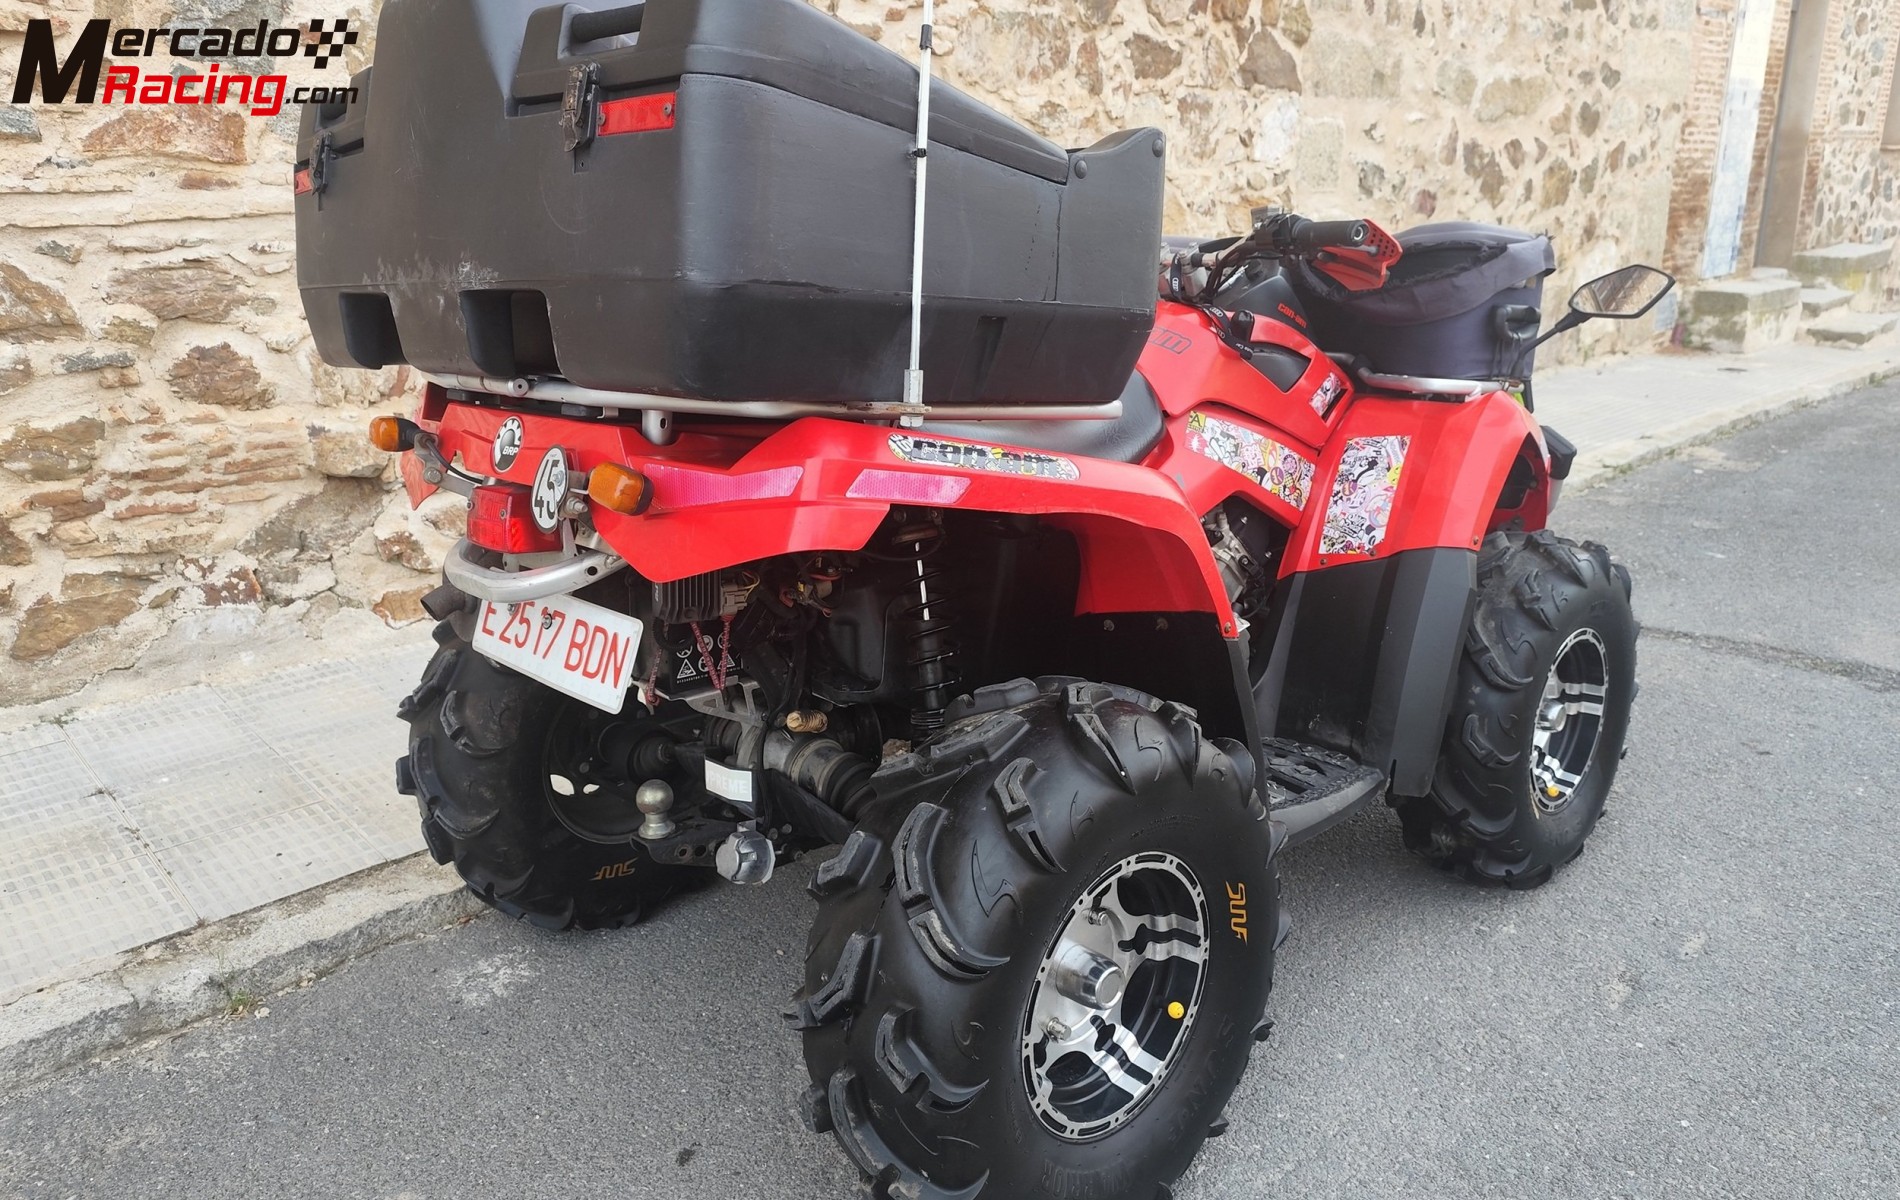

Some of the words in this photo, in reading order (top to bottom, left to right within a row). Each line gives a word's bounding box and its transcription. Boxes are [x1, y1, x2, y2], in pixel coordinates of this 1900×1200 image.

[502, 445, 519, 456] BRP
[534, 459, 561, 520] 45
[481, 601, 498, 637] E
[498, 601, 567, 660] 2517
[564, 618, 631, 689] BDN
